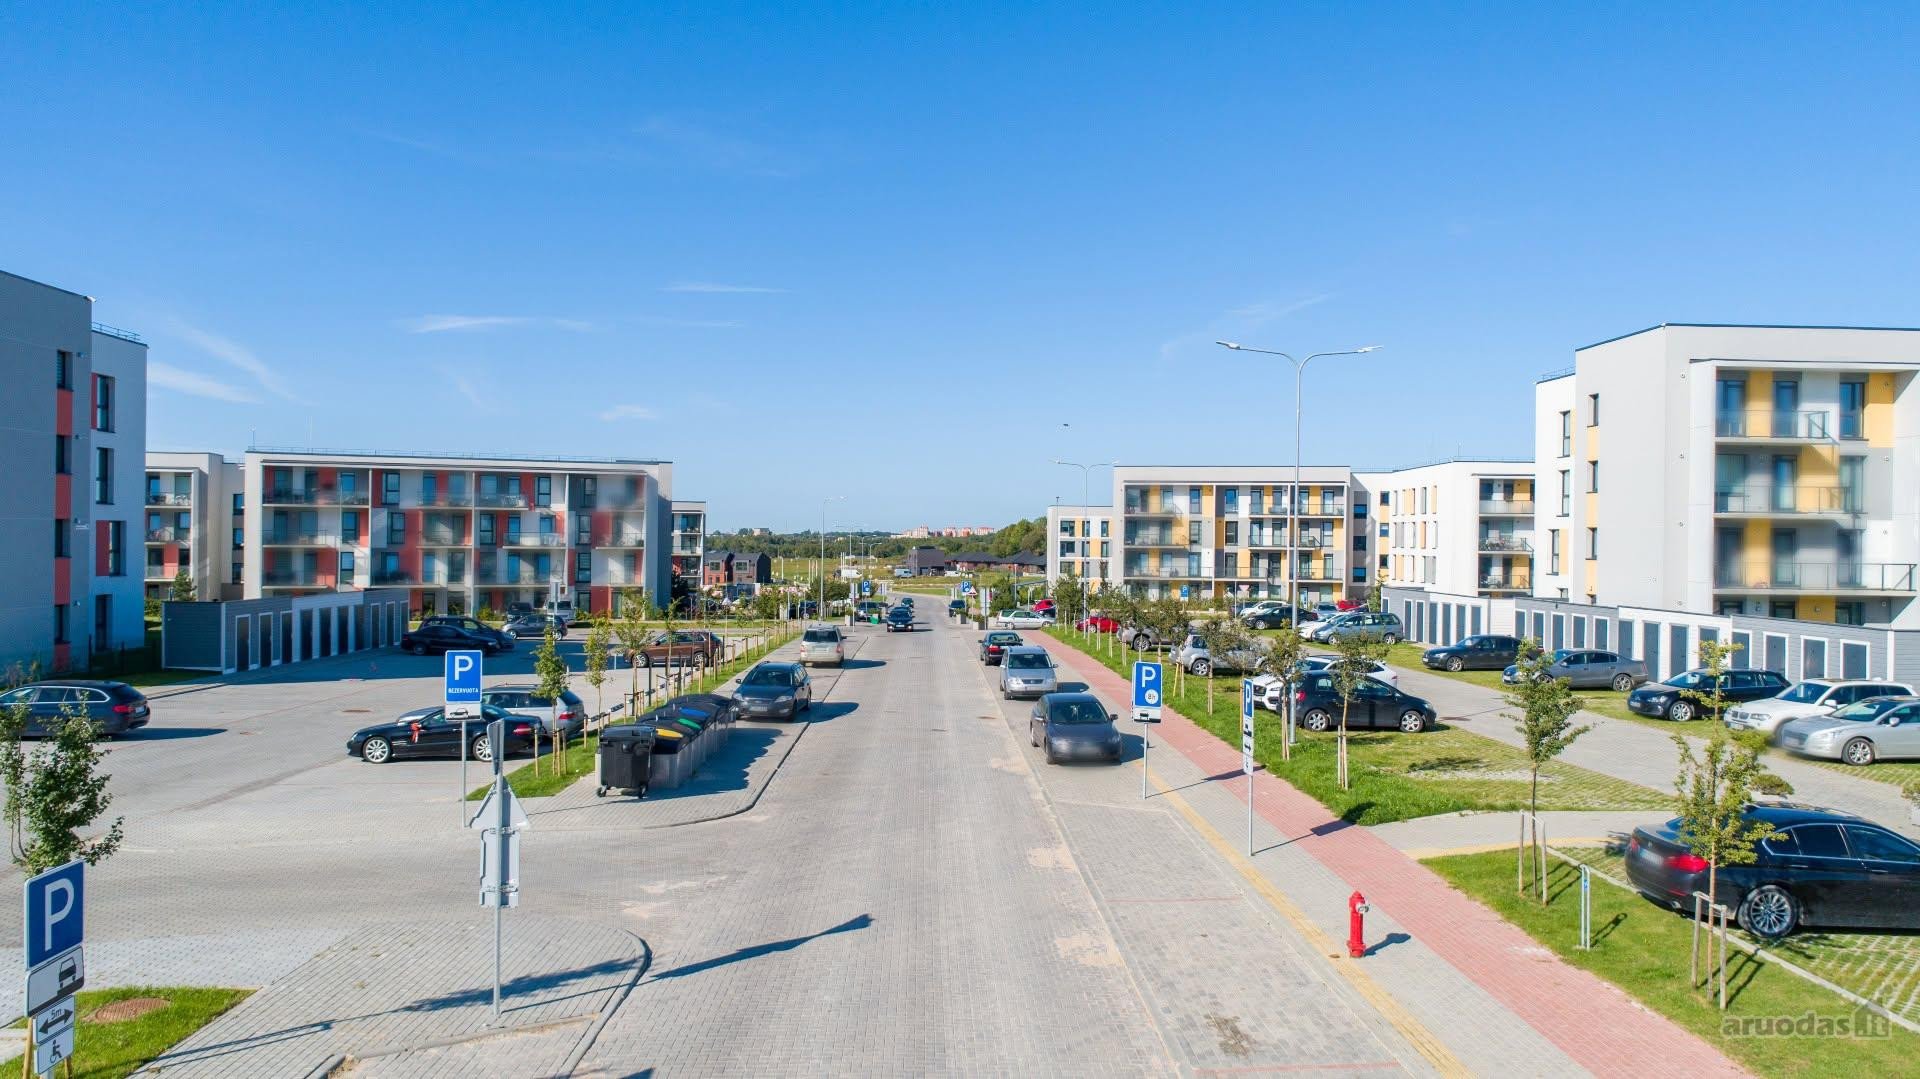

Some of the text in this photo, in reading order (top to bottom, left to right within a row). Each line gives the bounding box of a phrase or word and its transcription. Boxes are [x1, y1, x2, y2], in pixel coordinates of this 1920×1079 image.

[454, 655, 473, 681] P
[1141, 666, 1156, 688] P
[1245, 683, 1251, 712] P
[44, 877, 75, 952] P
[50, 1008, 62, 1020] 5m
